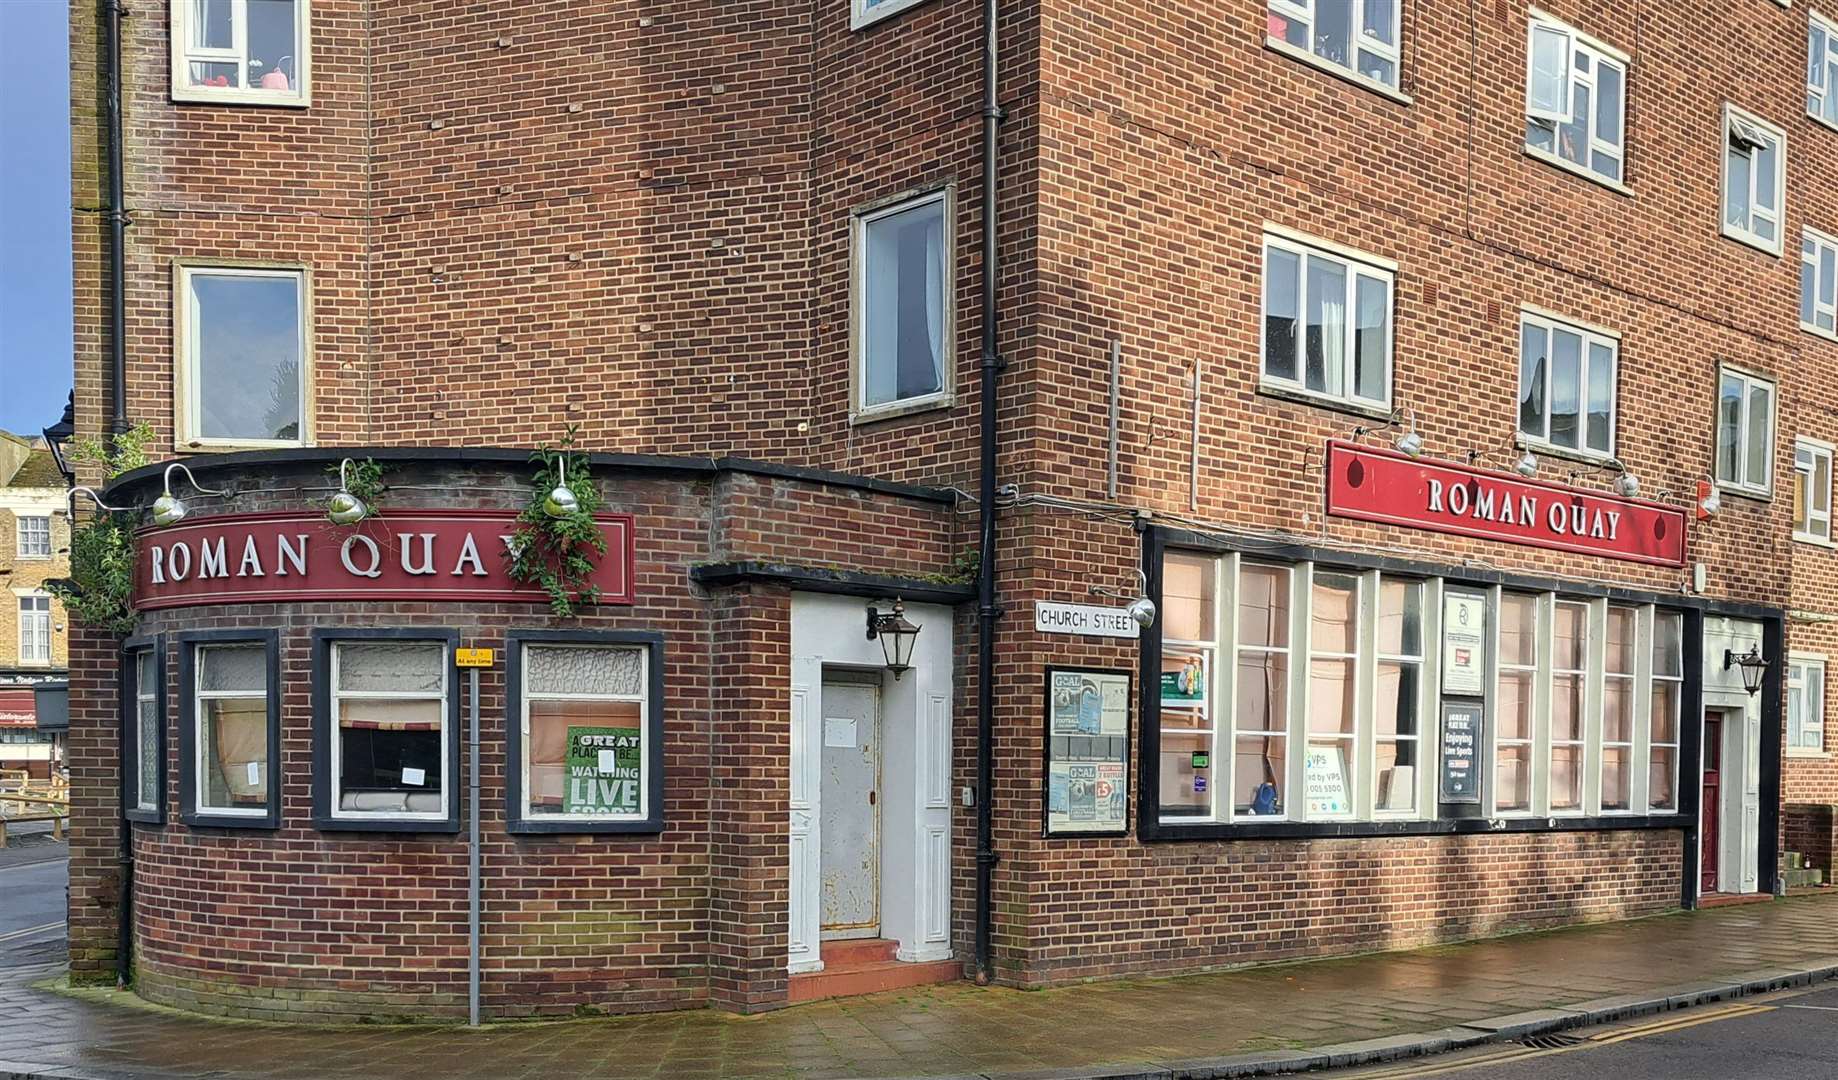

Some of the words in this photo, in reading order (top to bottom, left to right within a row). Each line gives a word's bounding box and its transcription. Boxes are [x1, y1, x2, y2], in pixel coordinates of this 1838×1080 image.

[1427, 479, 1538, 528] ROMAN
[1548, 502, 1621, 540] QUAY
[151, 534, 309, 584] ROMAN
[1041, 609, 1087, 627] CHURCH
[1094, 613, 1134, 631] STREET
[572, 736, 579, 746] A
[580, 735, 640, 748] GREAT
[1445, 732, 1473, 746] Enjoying
[572, 746, 599, 758] PLAC
[1070, 767, 1095, 777] GOAL
[1317, 773, 1325, 782] by
[571, 778, 638, 806] LIVE
